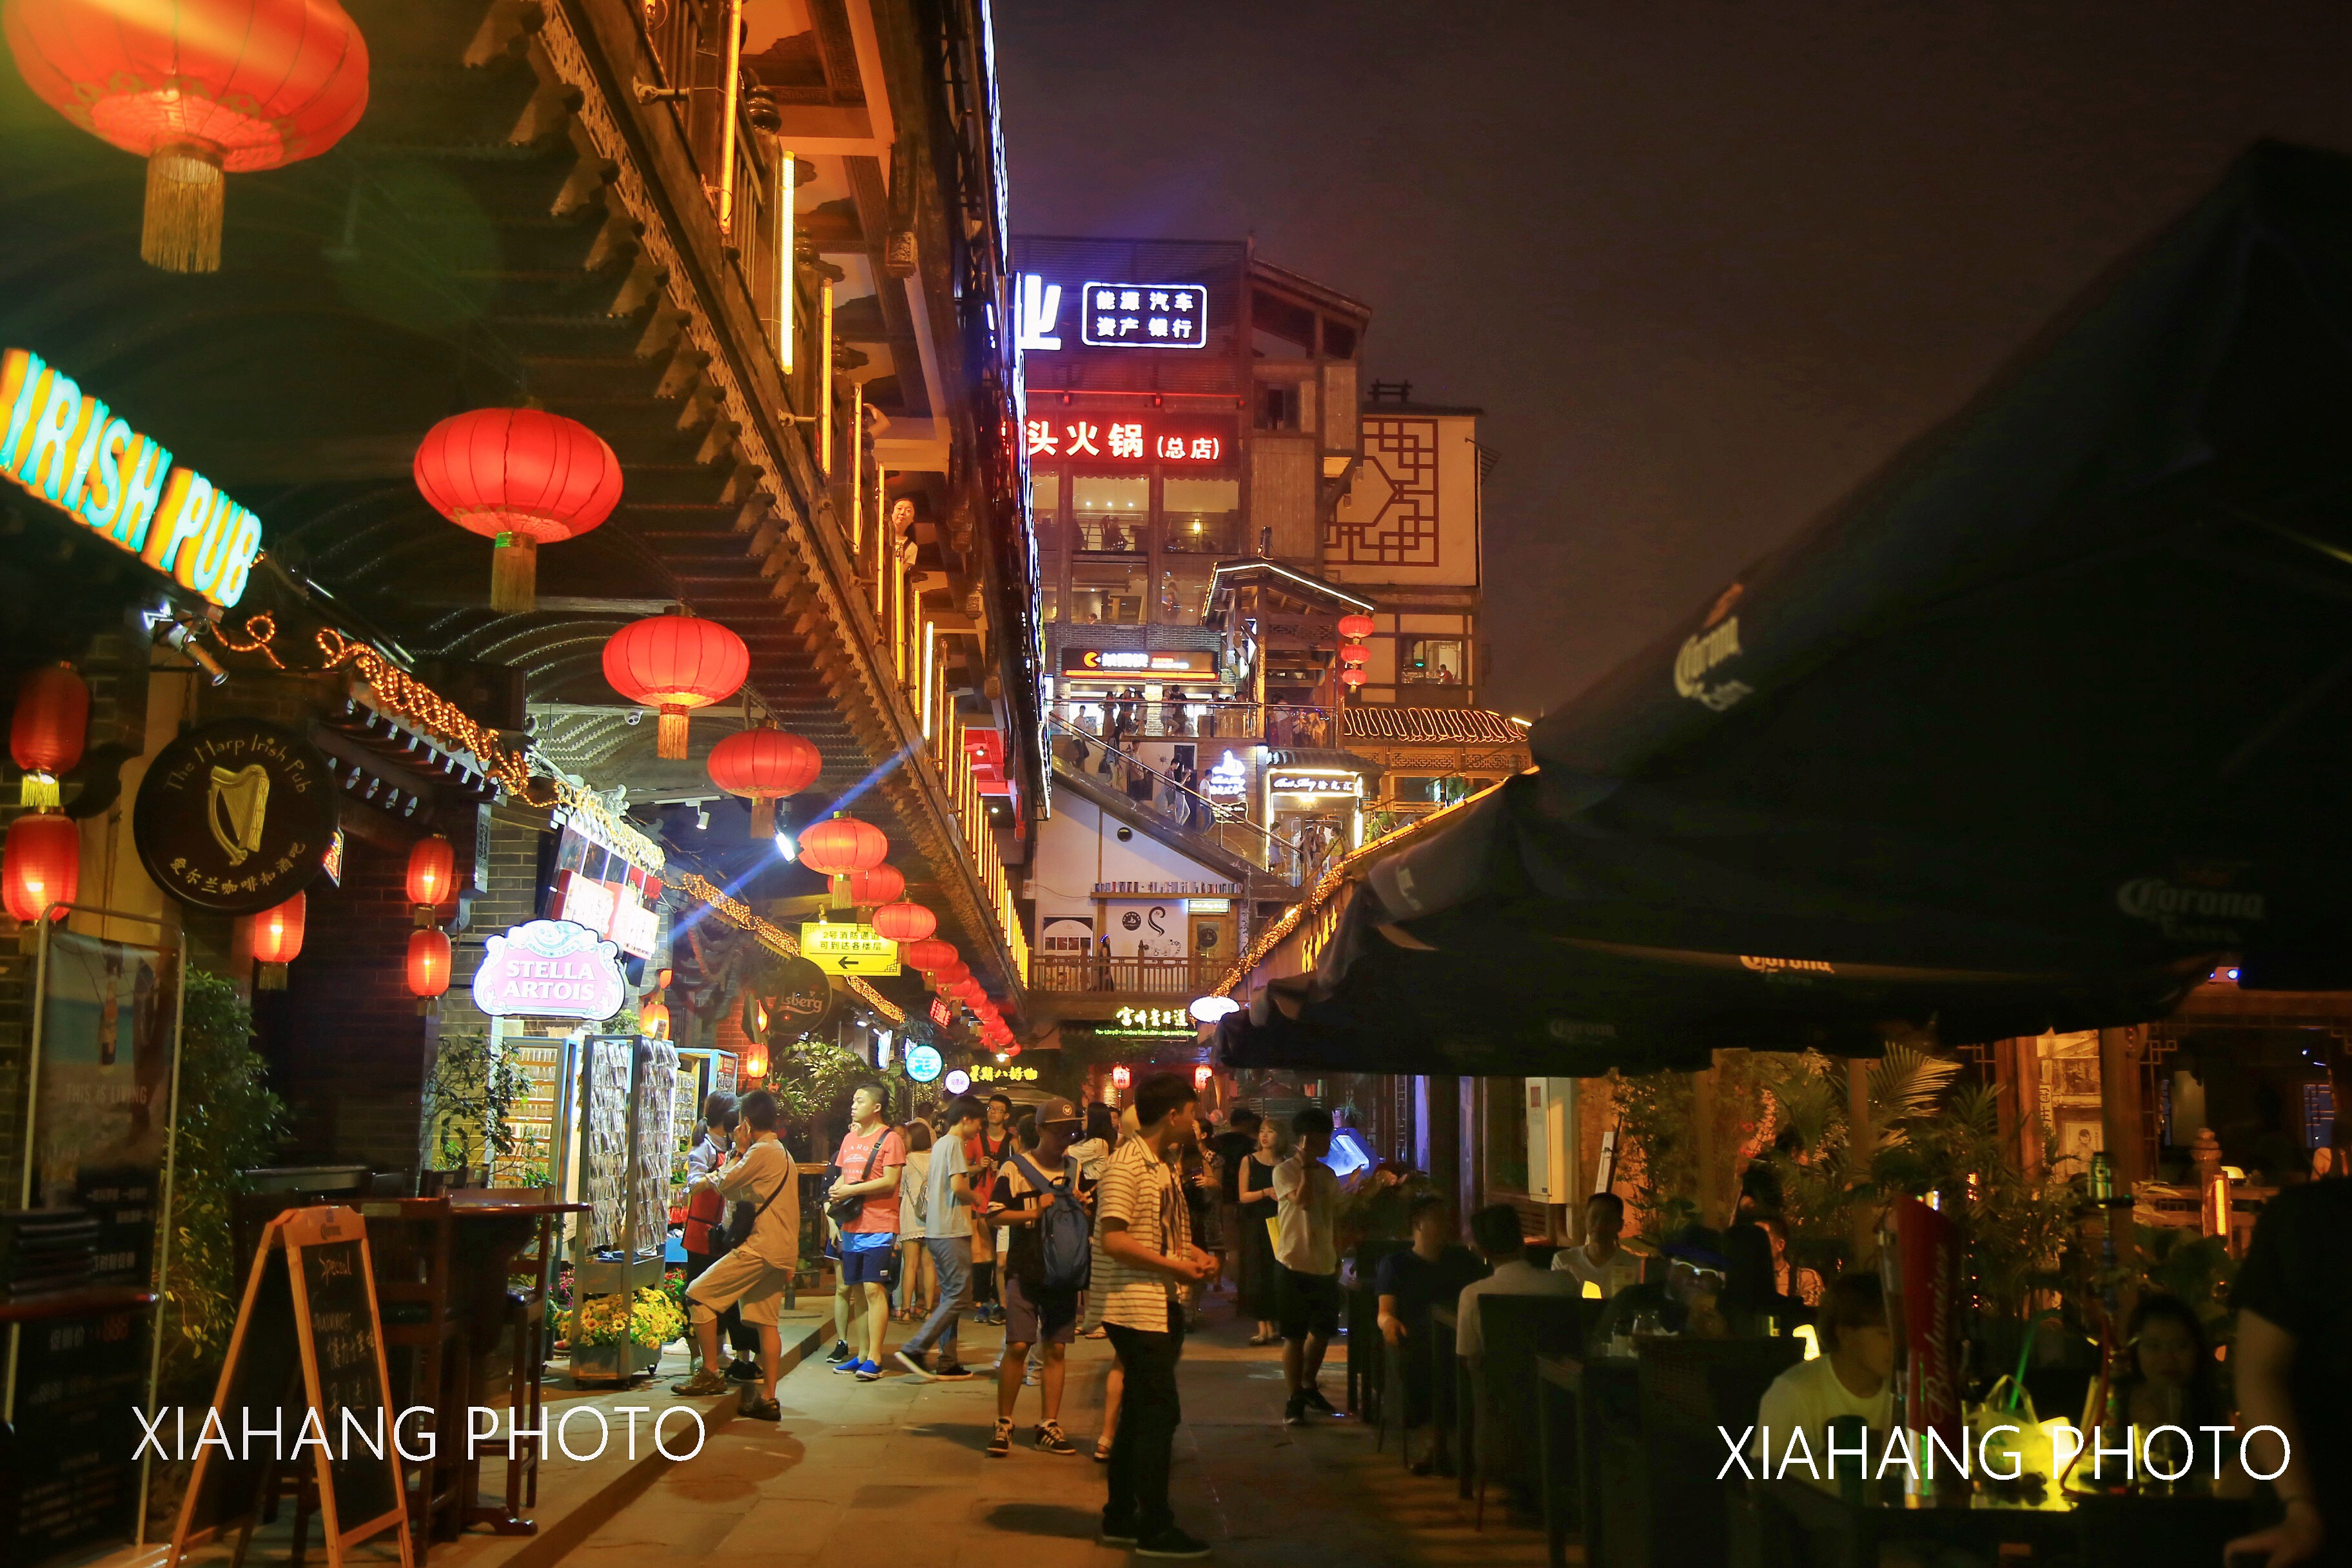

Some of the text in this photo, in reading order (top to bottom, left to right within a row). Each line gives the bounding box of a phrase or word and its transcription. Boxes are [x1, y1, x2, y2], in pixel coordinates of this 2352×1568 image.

[0, 350, 263, 608] IRISH PUB
[164, 734, 311, 792] The Harp Irish Pub
[819, 941, 882, 951] 可到达各楼层
[505, 959, 596, 981] STELLA
[502, 980, 596, 1001] ARTOIS
[66, 1084, 91, 1103] THIS
[97, 1085, 107, 1104] IS
